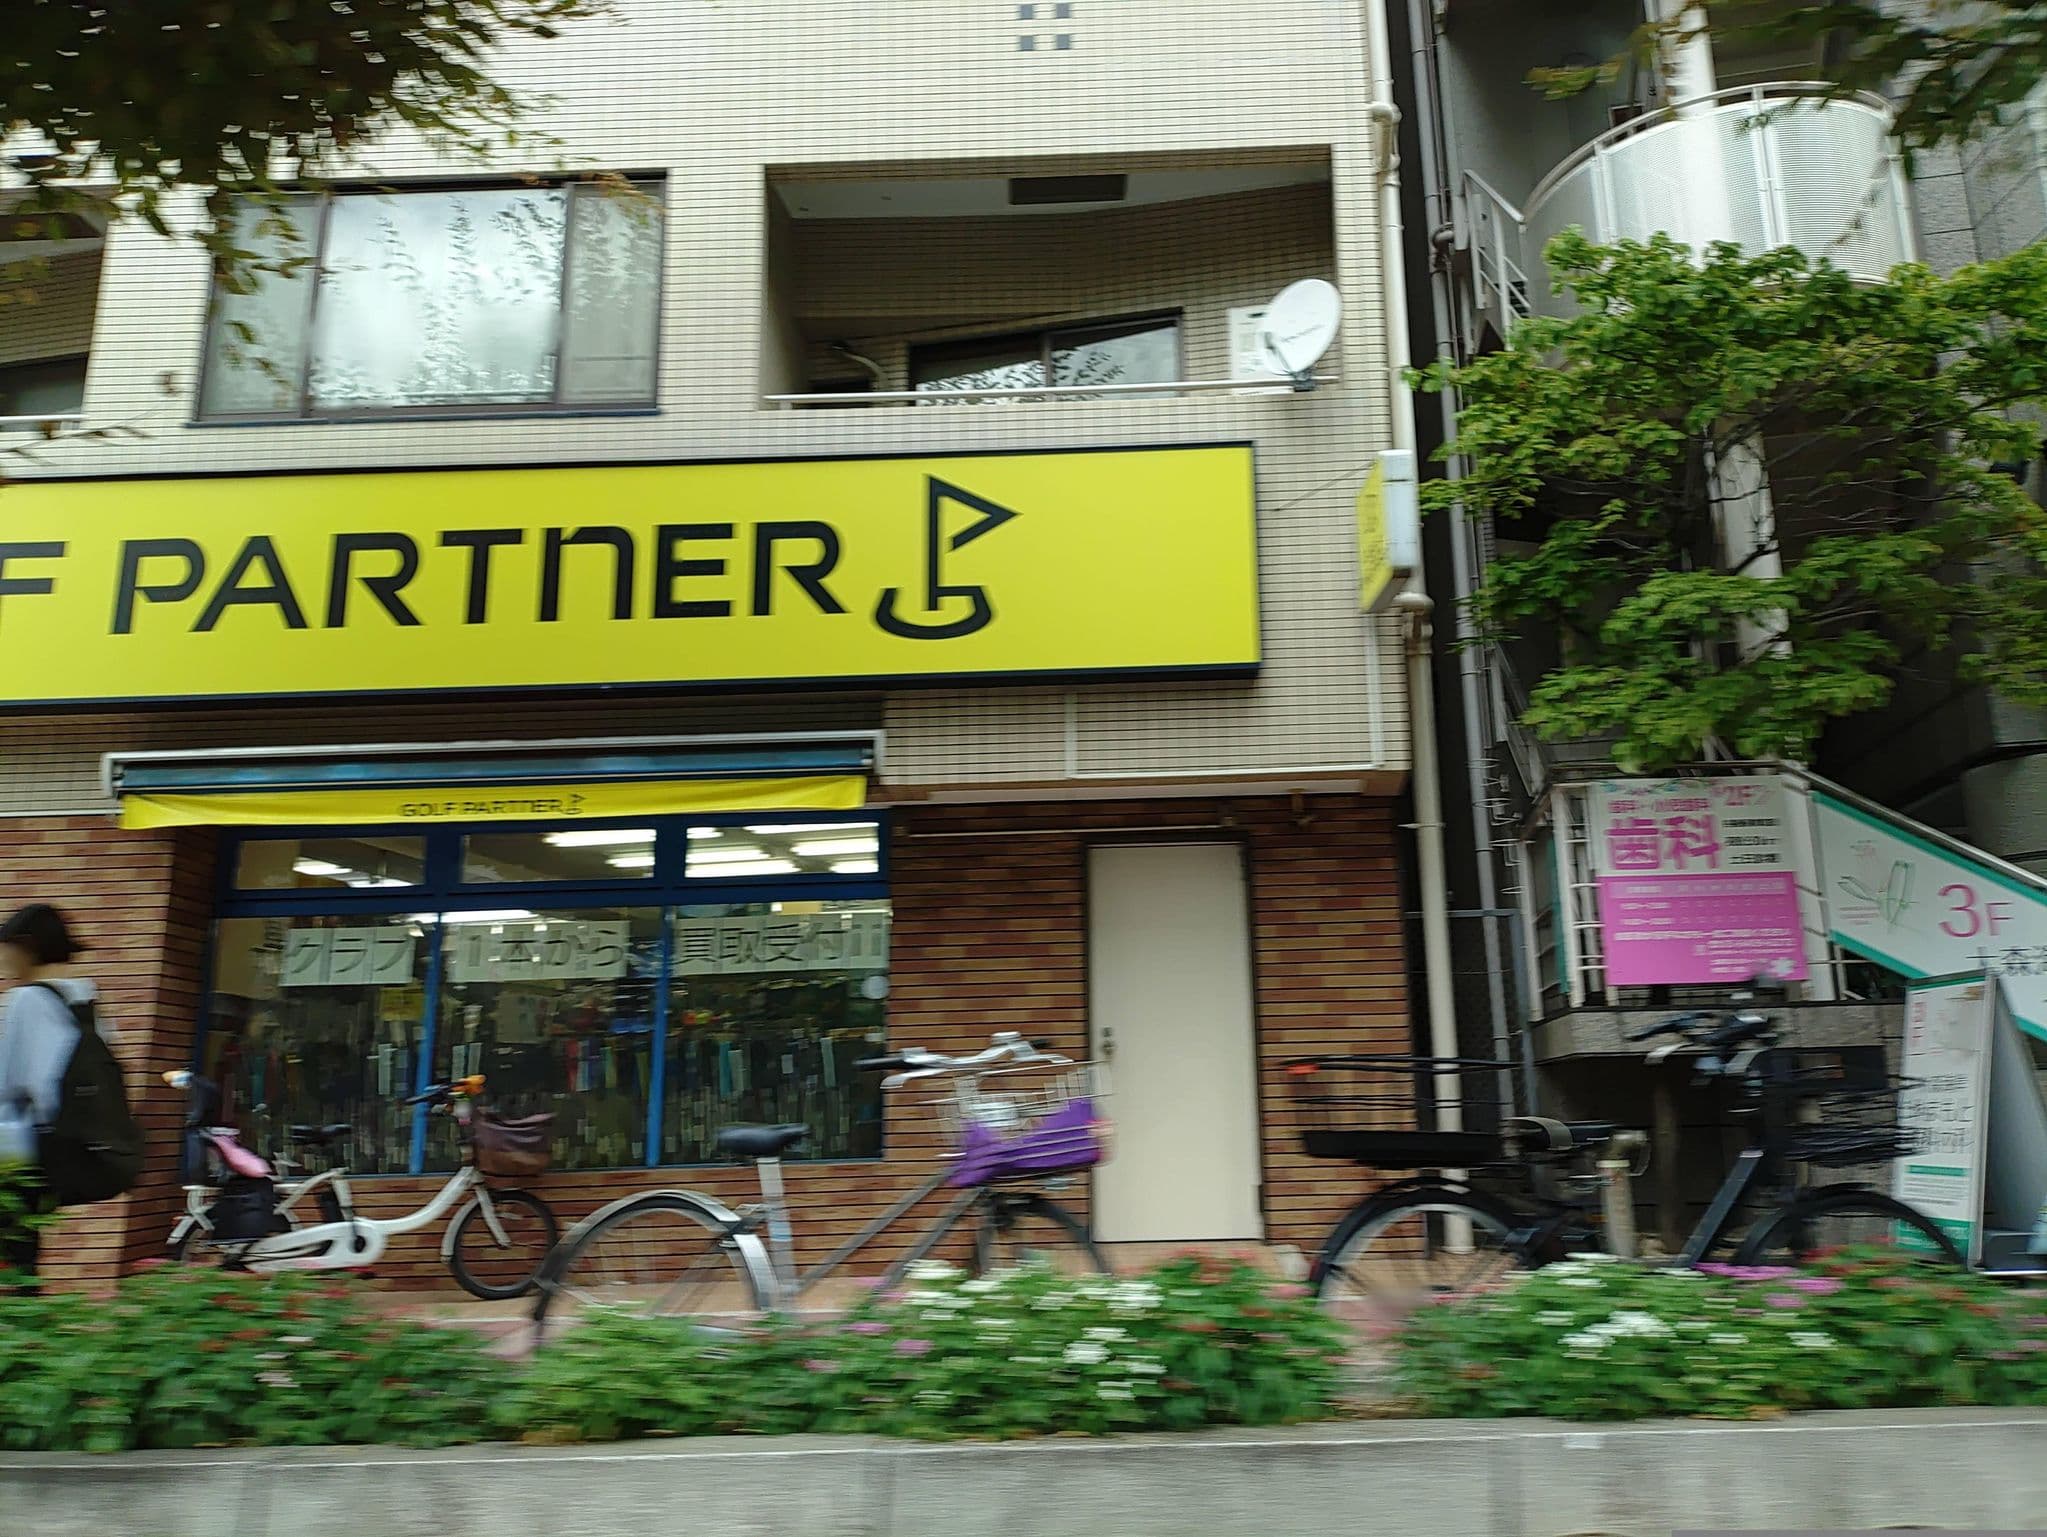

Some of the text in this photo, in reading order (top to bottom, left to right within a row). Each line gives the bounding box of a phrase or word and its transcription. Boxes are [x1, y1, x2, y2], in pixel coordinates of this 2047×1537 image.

[402, 803, 458, 817] GOLF
[1606, 814, 1721, 870] 歯科
[1938, 883, 2014, 937] 3F
